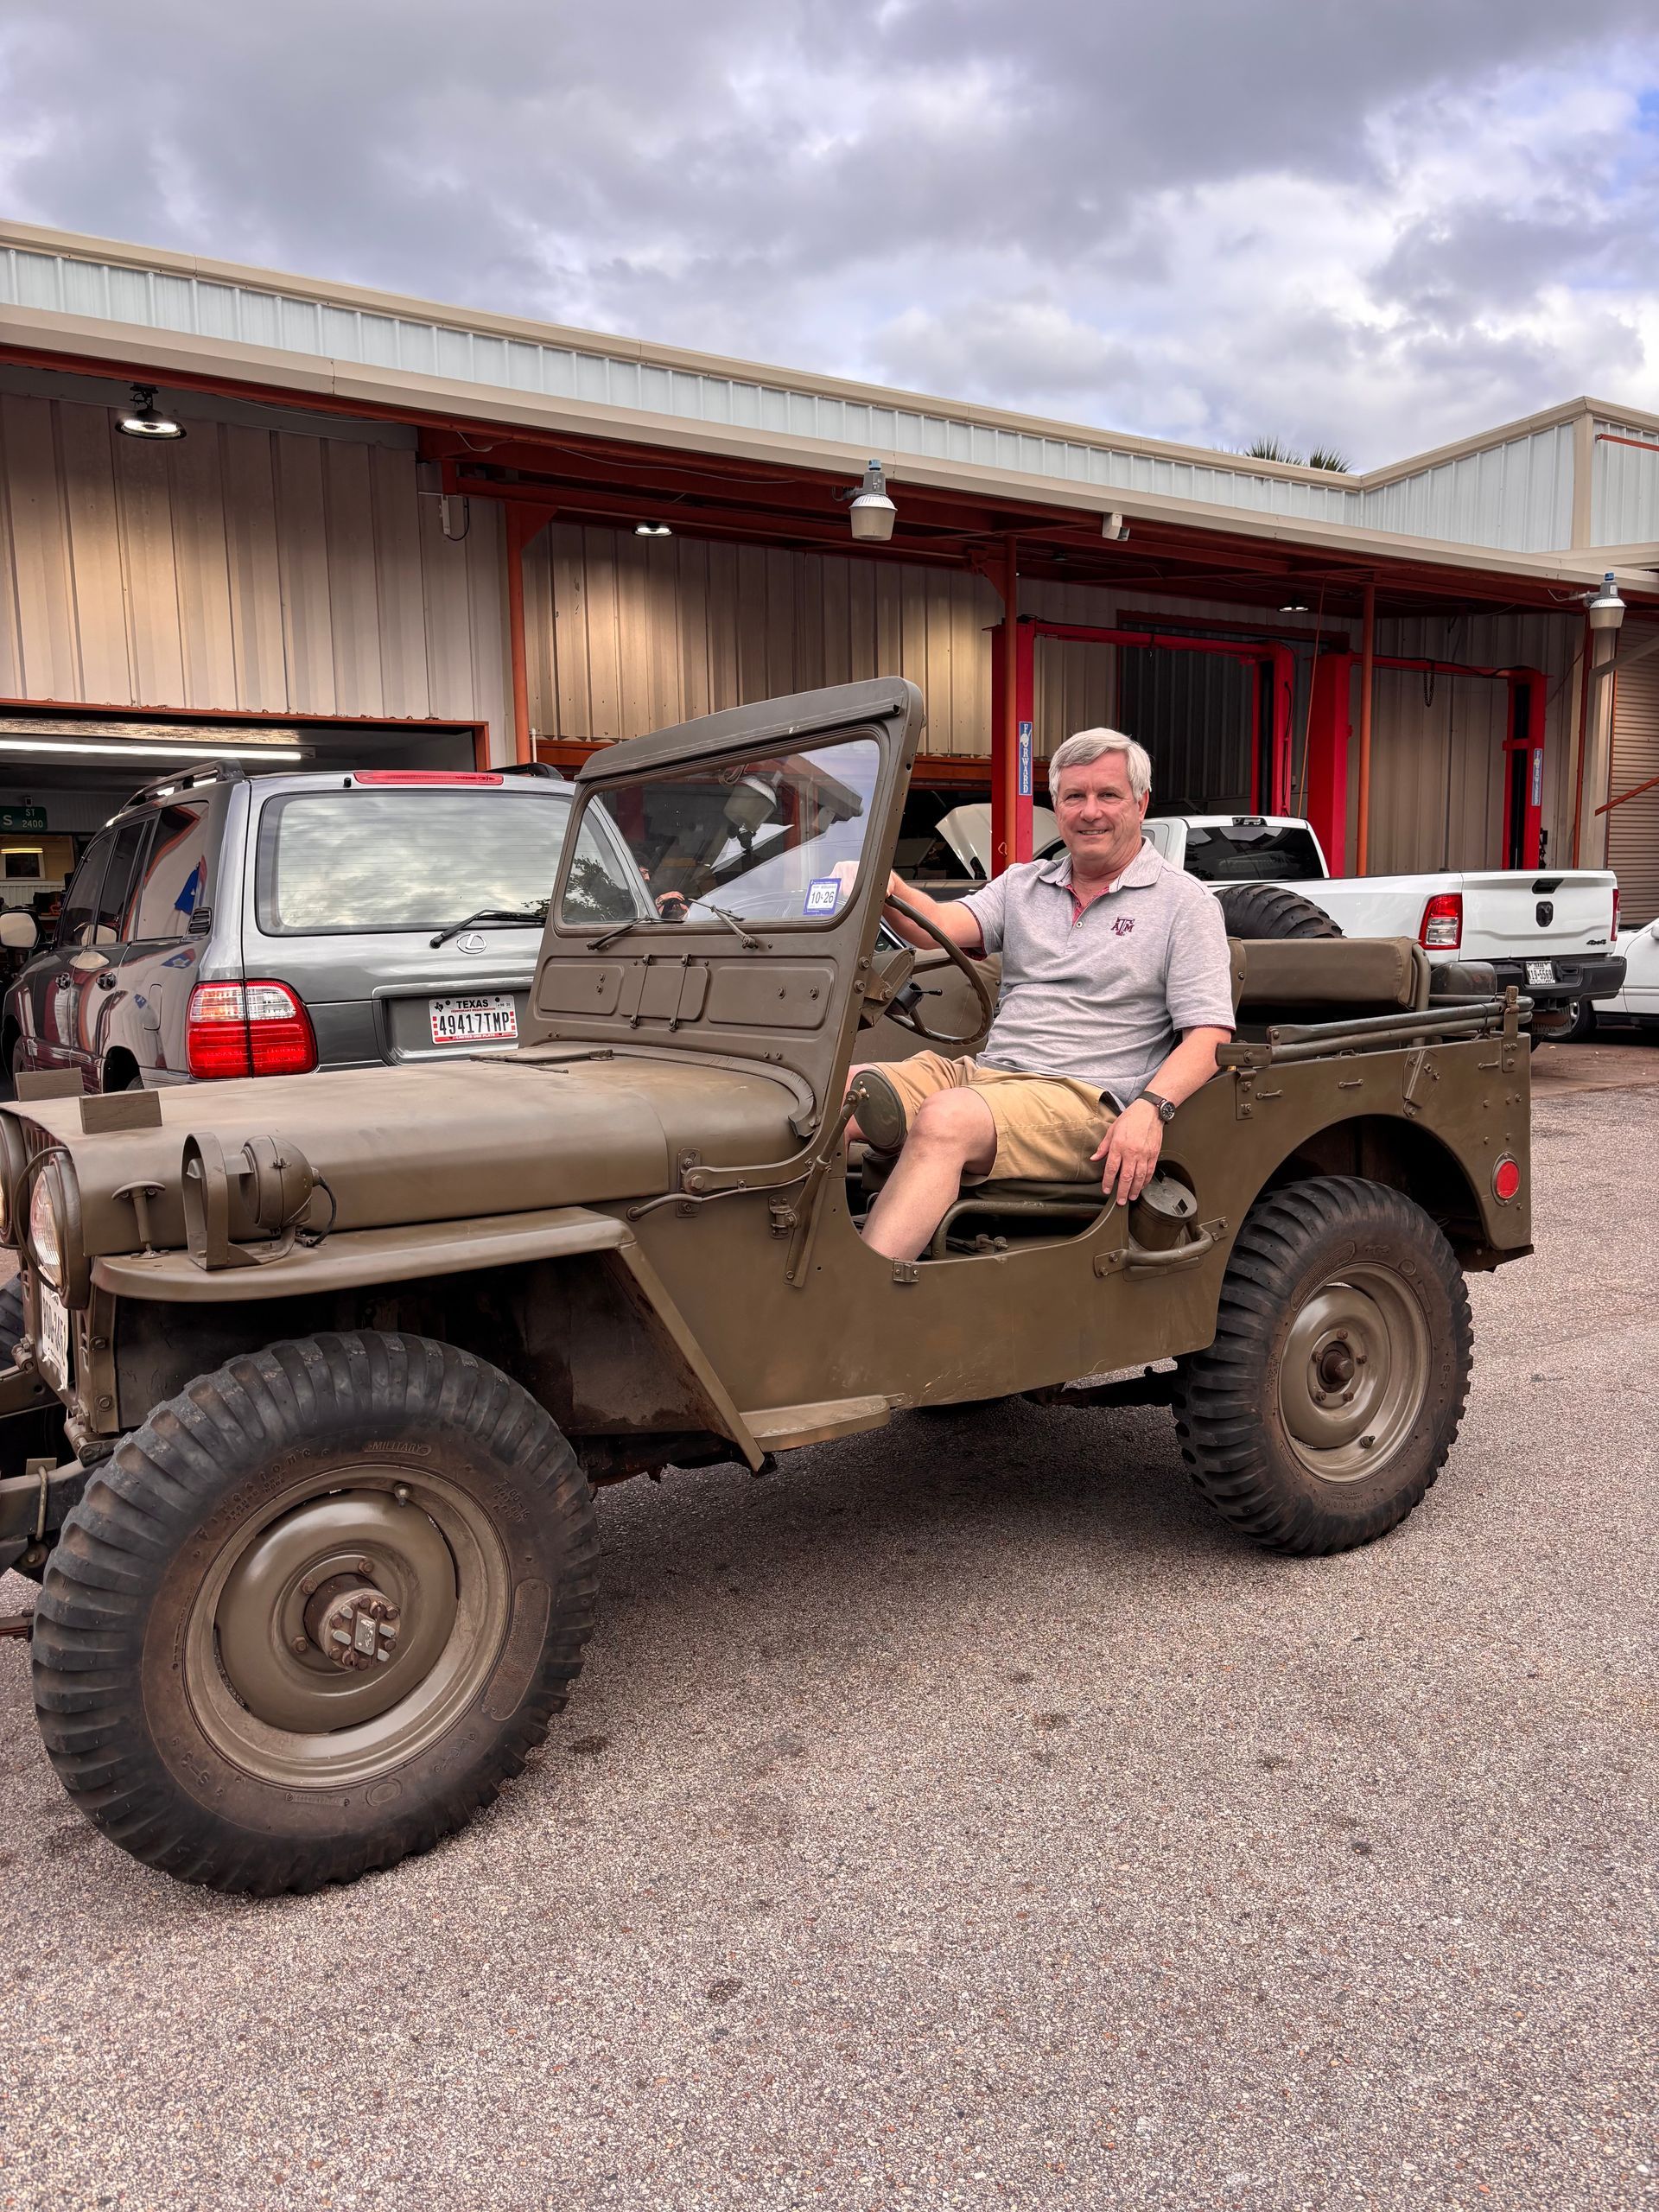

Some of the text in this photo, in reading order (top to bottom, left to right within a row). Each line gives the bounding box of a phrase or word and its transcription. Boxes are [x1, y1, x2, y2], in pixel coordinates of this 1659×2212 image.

[26, 808, 35, 817] ST
[22, 819, 44, 829] 2400
[456, 999, 489, 1009] TEXAS
[439, 1012, 509, 1036] 49417TMP
